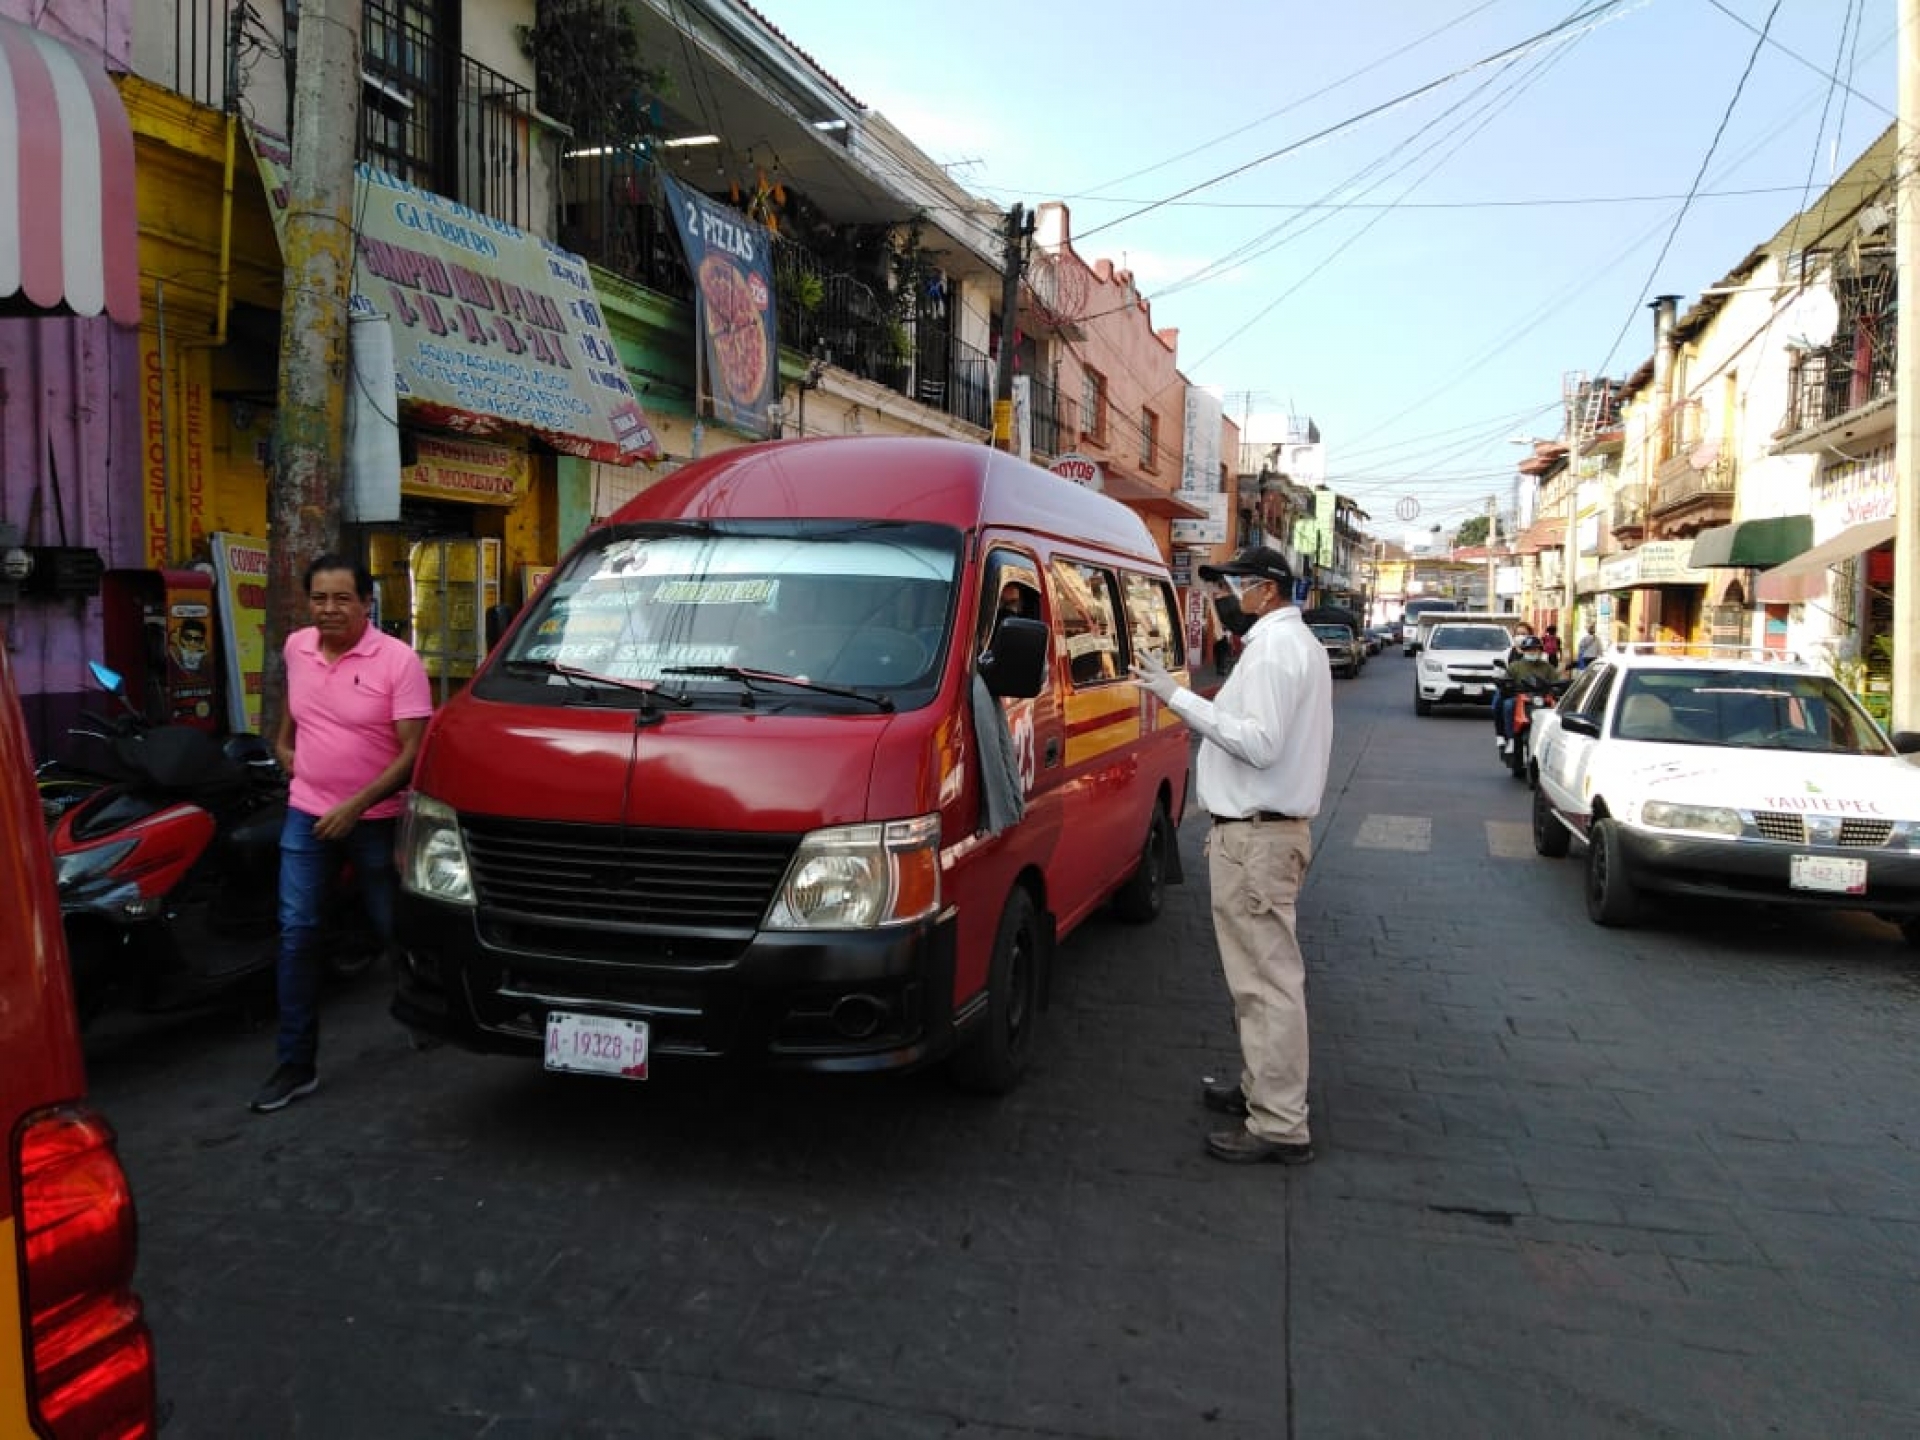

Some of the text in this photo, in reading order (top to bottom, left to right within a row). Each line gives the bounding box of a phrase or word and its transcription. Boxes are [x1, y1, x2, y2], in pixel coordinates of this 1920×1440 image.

[685, 201, 754, 262] 2 PIZZAS
[357, 234, 453, 298] COMPRO
[449, 263, 495, 311] ORO
[437, 468, 515, 493] MOMENTO
[1764, 796, 1885, 814] YAUTEPEC
